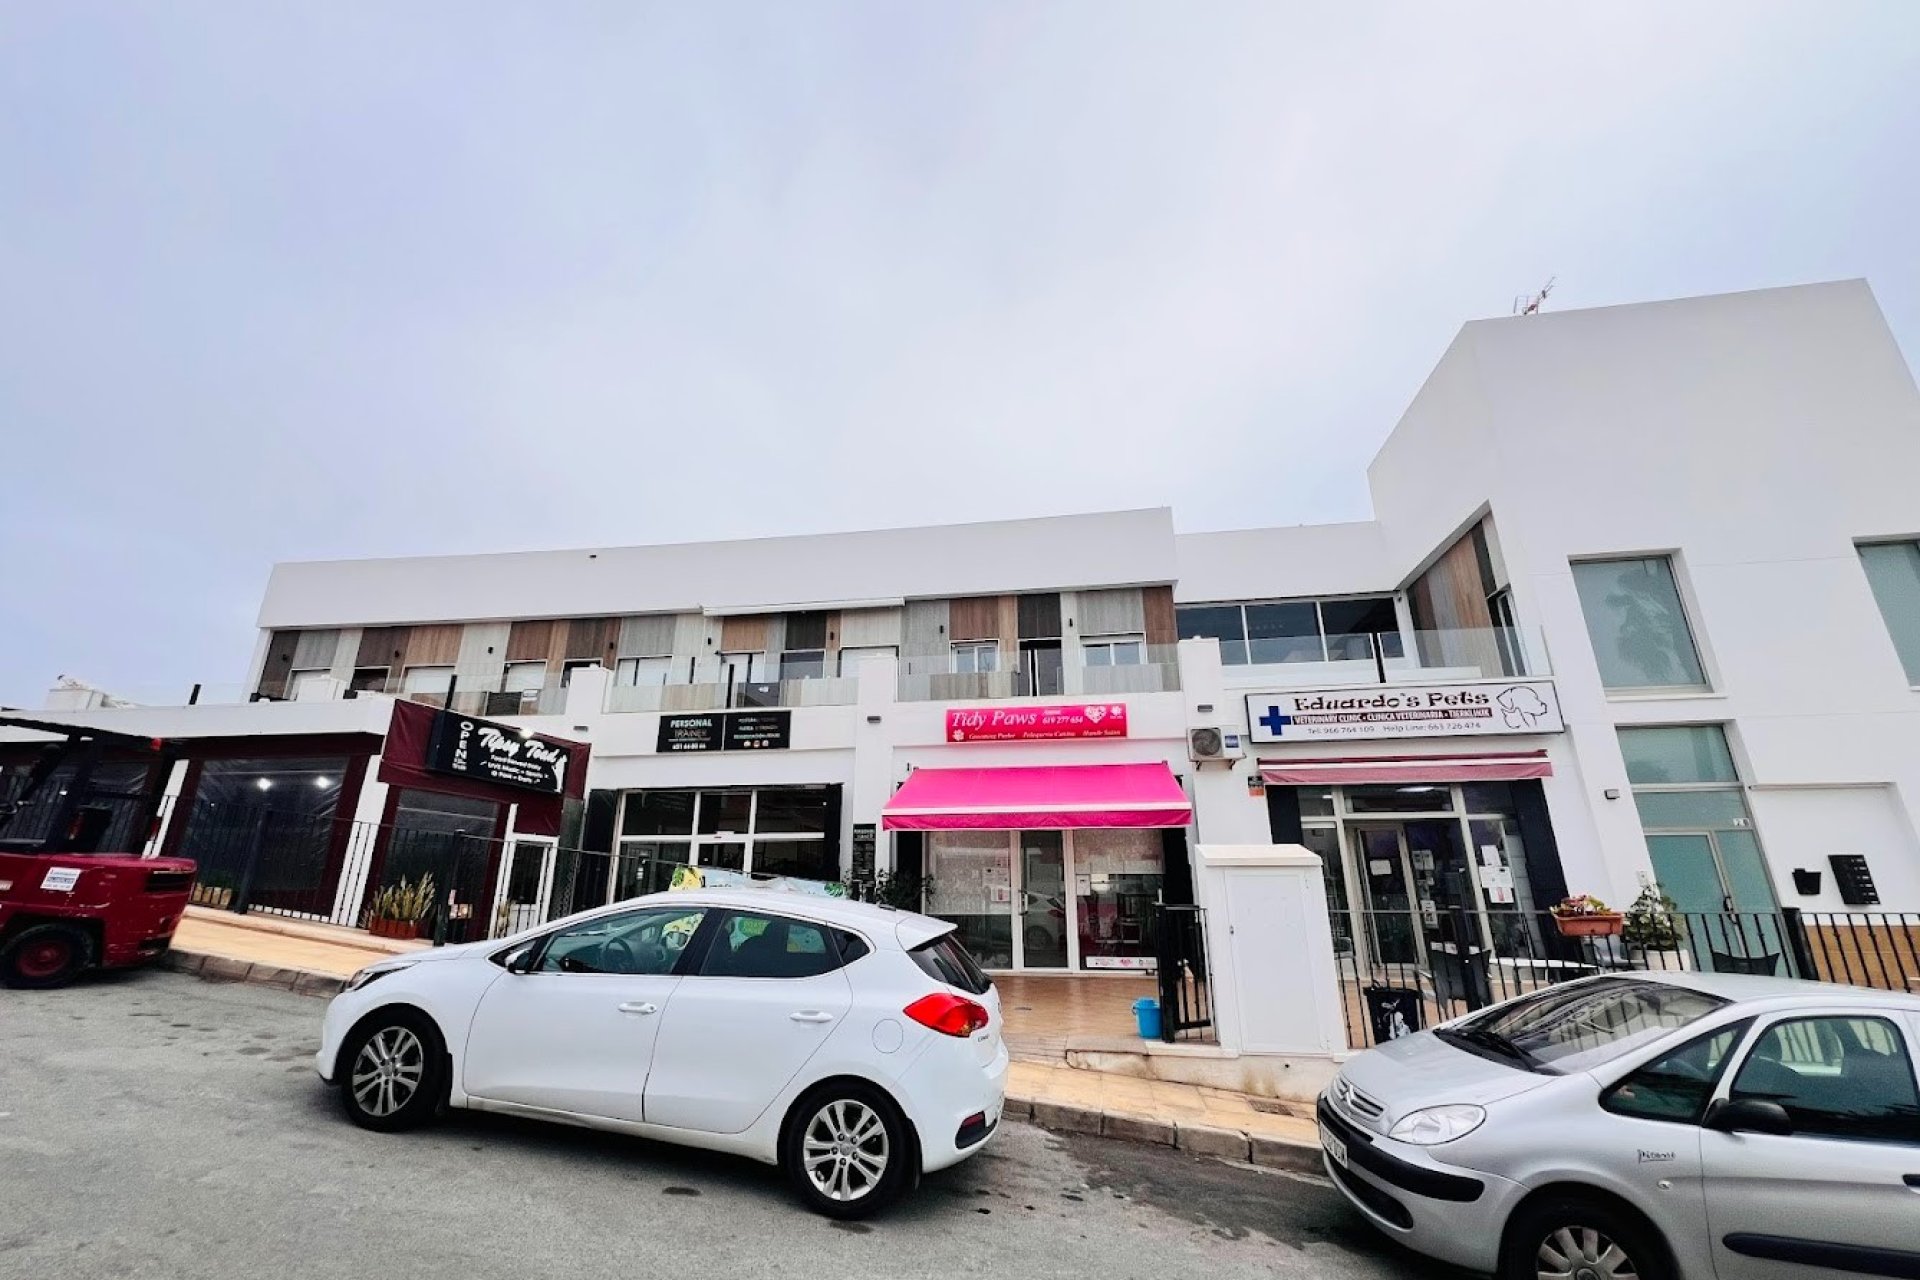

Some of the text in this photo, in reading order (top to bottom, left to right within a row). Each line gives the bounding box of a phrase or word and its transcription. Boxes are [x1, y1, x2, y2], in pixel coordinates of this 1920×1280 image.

[1293, 691, 1490, 711] Eduardo's Pets
[670, 718, 713, 728] PERSONAL
[951, 710, 1037, 730] Tidy Paws
[1295, 715, 1337, 725] VETERINARY
[1339, 714, 1361, 723] CLINIC
[1383, 725, 1404, 733] Help
[454, 721, 474, 759] OPEN
